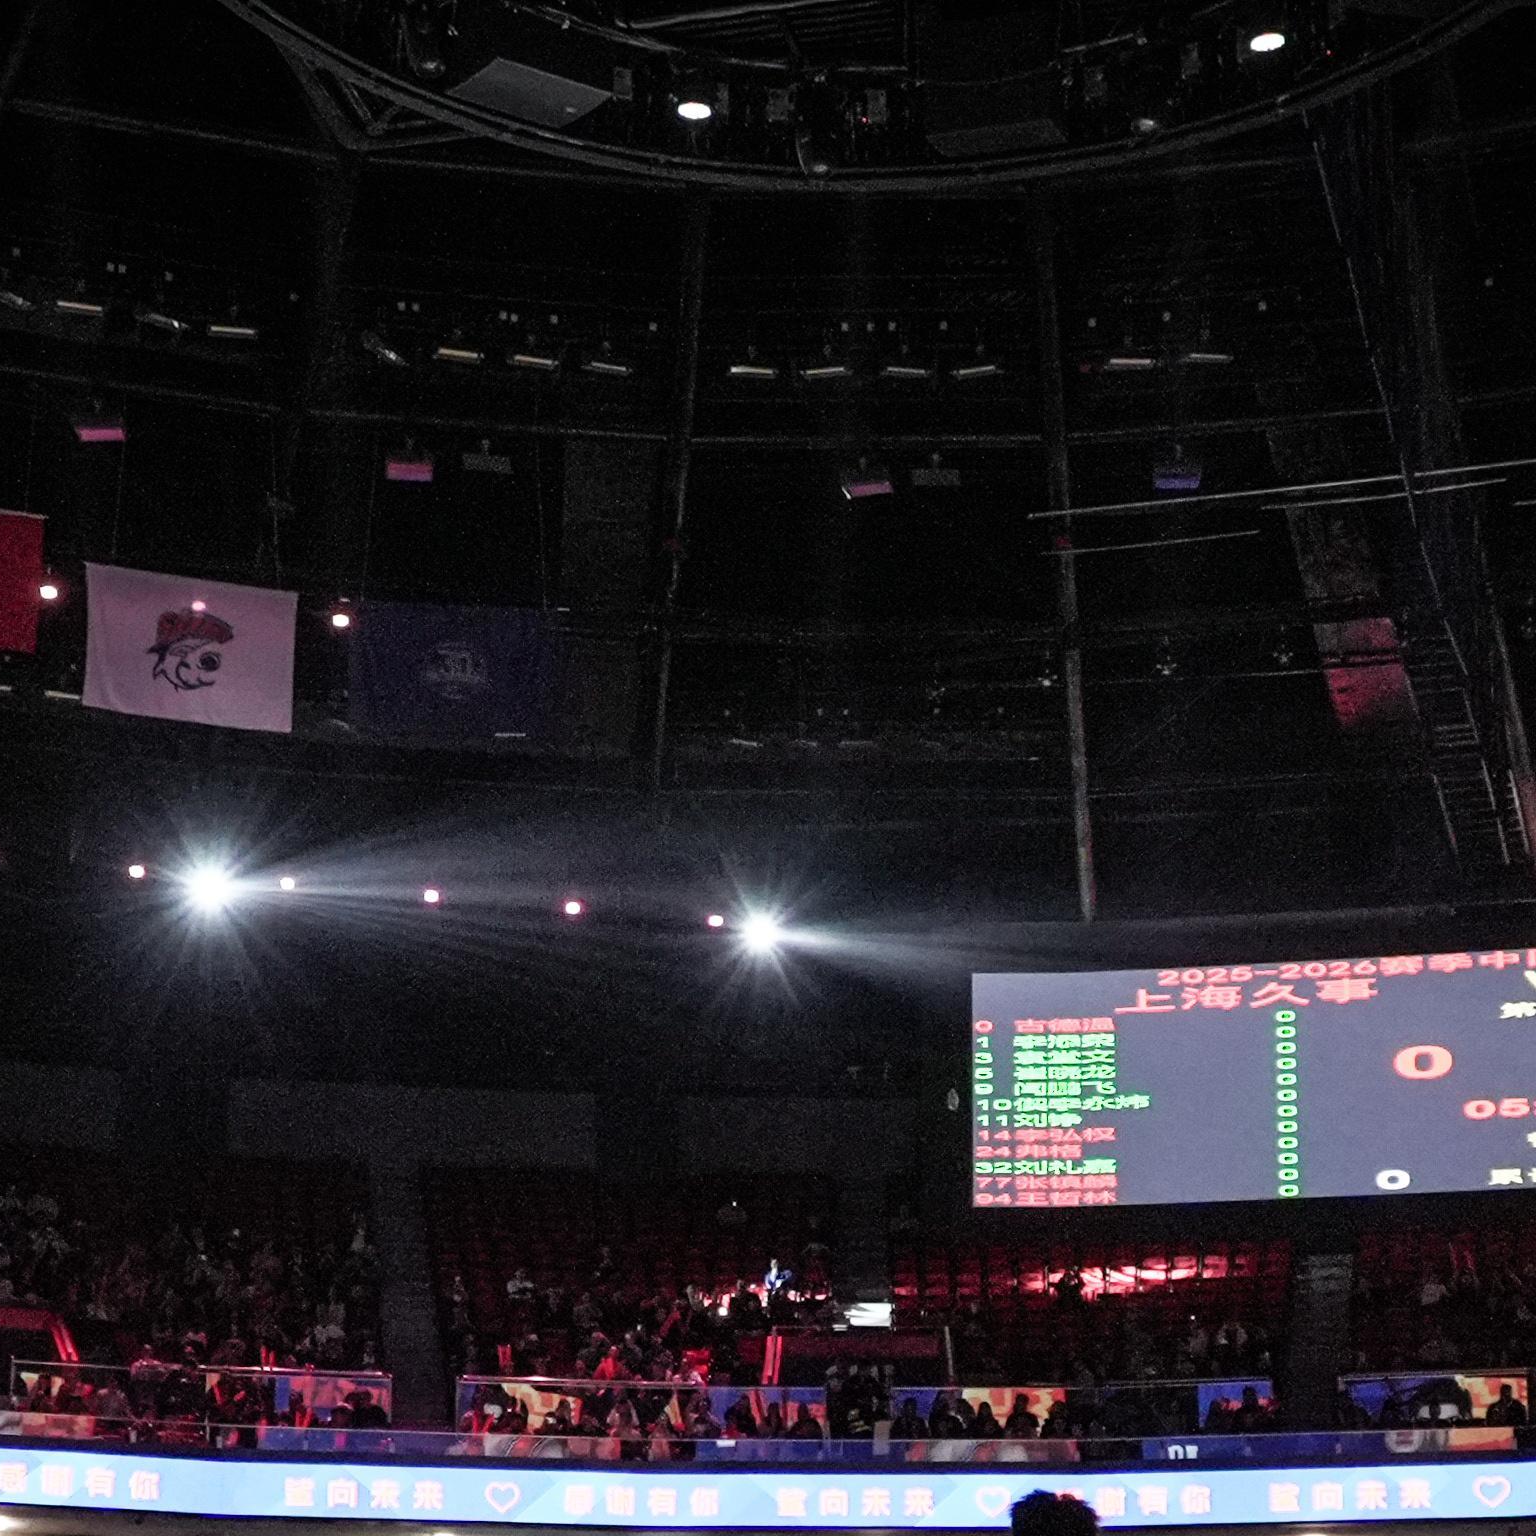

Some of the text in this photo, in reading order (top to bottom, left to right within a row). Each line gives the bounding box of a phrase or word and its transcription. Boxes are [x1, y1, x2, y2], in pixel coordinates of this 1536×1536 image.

[1114, 977, 1378, 1014] 上海久事
[975, 1019, 993, 1034] 0
[1275, 1010, 1297, 1023] 0
[976, 1036, 989, 1048] 1
[1275, 1026, 1297, 1039] 0
[974, 1052, 993, 1064] 3
[1275, 1042, 1297, 1055] 0
[1393, 1045, 1454, 1080] 0
[974, 1067, 993, 1080] 5
[1276, 1057, 1298, 1070] 0
[974, 1083, 993, 1095] 9
[1276, 1073, 1298, 1086] 0
[976, 1098, 1012, 1111] 10
[1276, 1089, 1298, 1102] 0
[976, 1114, 1008, 1127] 11
[1277, 1104, 1299, 1117] 0
[977, 1129, 1012, 1142] 14
[1277, 1121, 1299, 1134] 0
[975, 1145, 1012, 1158] 24
[1277, 1137, 1299, 1150] 0
[975, 1161, 1012, 1174] 32
[1277, 1152, 1299, 1165] 0
[976, 1176, 1013, 1190] 77
[1277, 1168, 1299, 1181] 0
[1375, 1168, 1411, 1190] 0
[1278, 1185, 1300, 1198] 0
[1095, 1484, 1212, 1517] 谢有你
